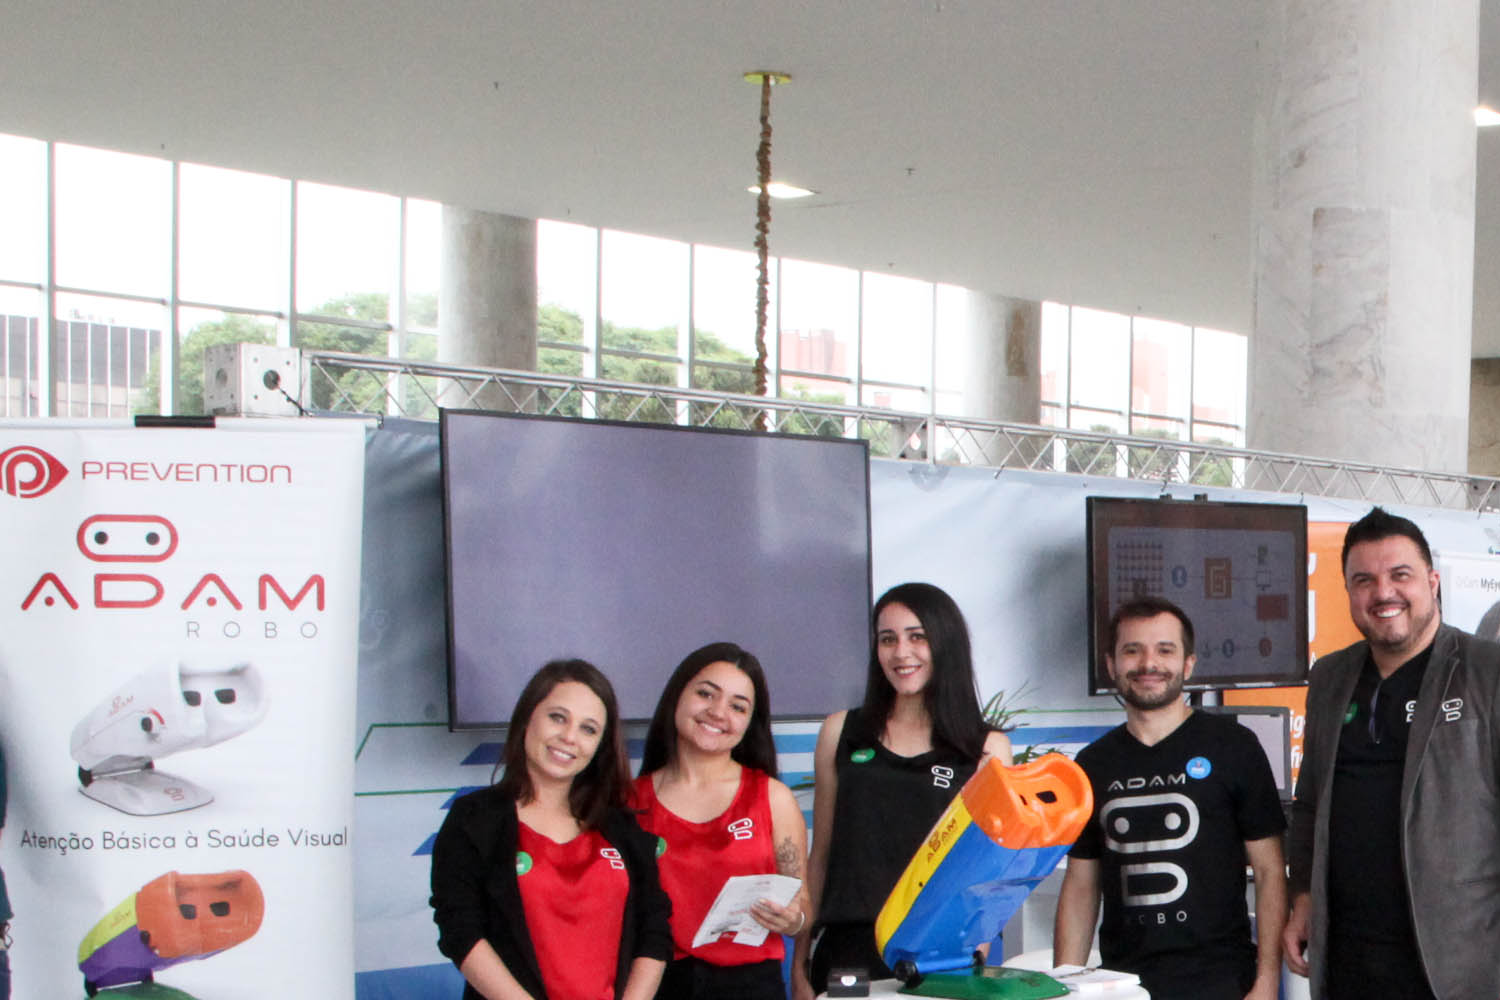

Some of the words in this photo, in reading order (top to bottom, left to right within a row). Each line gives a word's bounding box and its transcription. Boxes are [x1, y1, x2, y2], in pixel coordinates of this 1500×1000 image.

[82, 461, 292, 483] PREVENTION
[21, 572, 326, 612] ADAM
[187, 621, 318, 639] ROBO
[1108, 772, 1187, 792] ADAM
[20, 829, 94, 856] Atenção
[102, 830, 176, 850] Básica
[185, 831, 199, 849] à
[207, 828, 280, 849] Saúde
[287, 826, 348, 847] Visual
